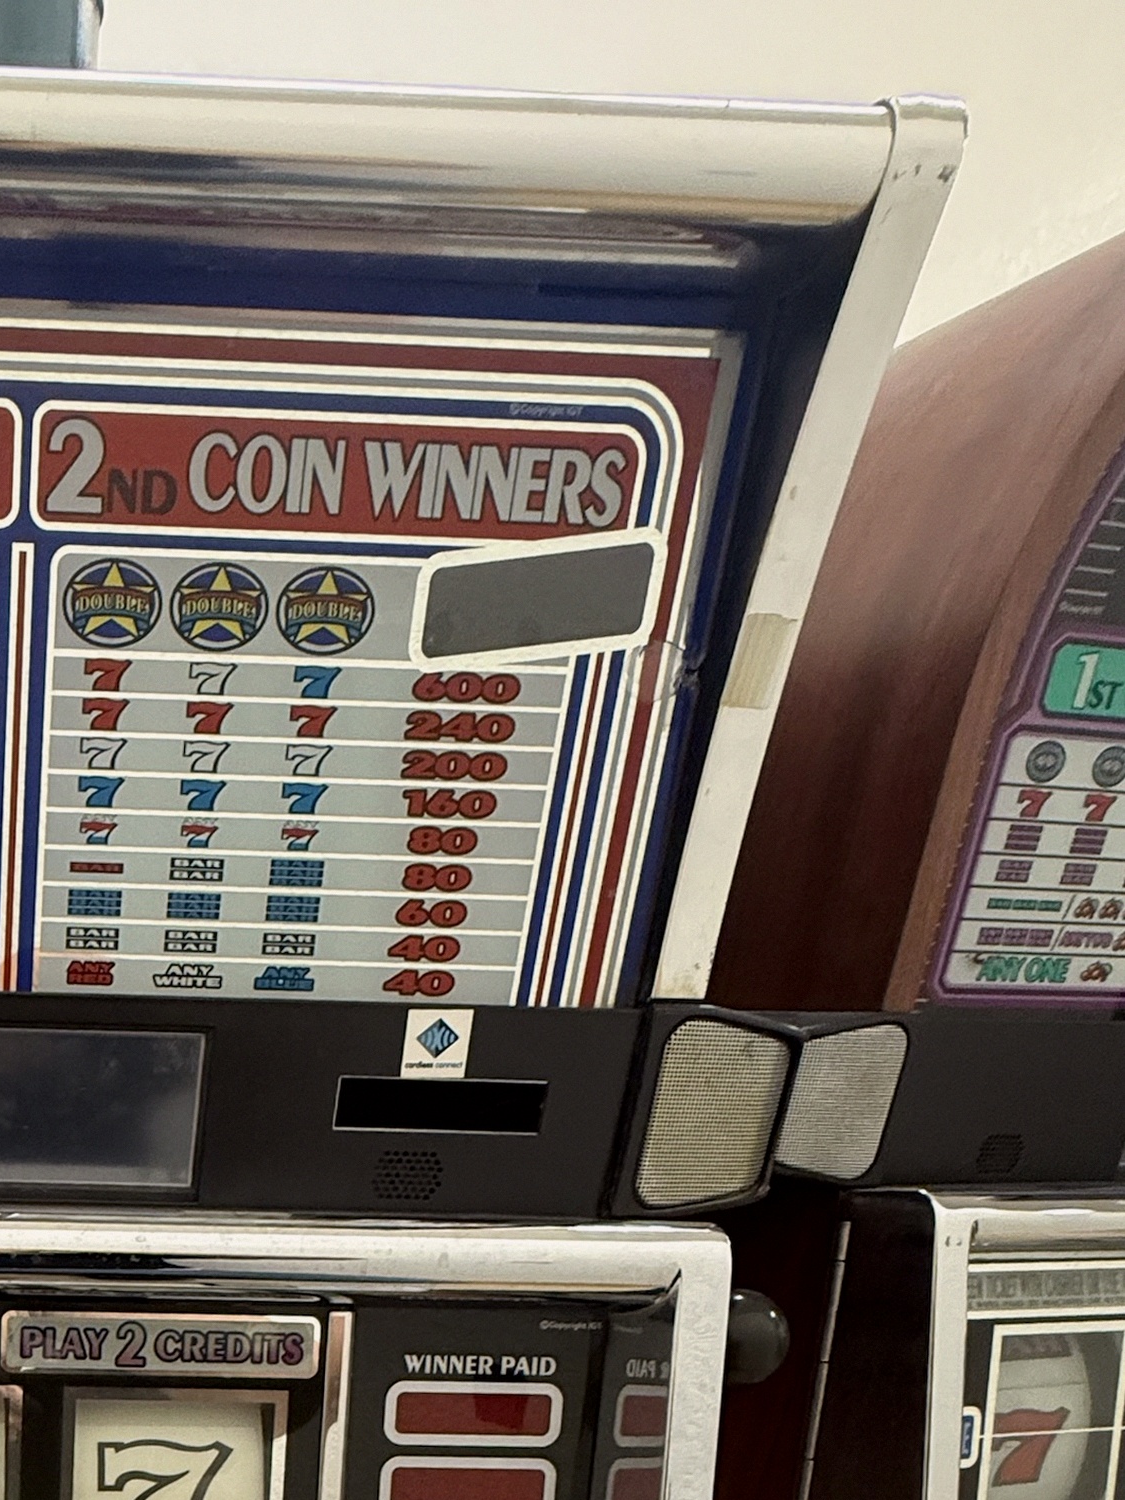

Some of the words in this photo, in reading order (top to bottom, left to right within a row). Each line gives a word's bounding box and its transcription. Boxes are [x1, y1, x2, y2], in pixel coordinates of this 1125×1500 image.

[45, 416, 177, 516] 2ND
[187, 430, 346, 516] COIN
[362, 440, 627, 529] WINNERS
[78, 594, 150, 616] DOUBLE
[186, 597, 256, 620] DOUBLE
[291, 601, 364, 623] DOUBLE
[411, 671, 522, 706] 600
[404, 708, 516, 744] 240
[400, 749, 508, 782] 200
[402, 788, 497, 821] 160
[407, 825, 478, 856] 80
[402, 863, 472, 892] 80
[395, 899, 469, 928] 60
[387, 935, 461, 963] 40
[383, 969, 455, 997] 40
[404, 1060, 433, 1069] cordless
[435, 1061, 463, 1069] connect
[20, 1325, 108, 1362] PLAY
[114, 1320, 148, 1368] 2
[153, 1327, 305, 1366] CREDITS
[404, 1353, 493, 1376] WINNER
[500, 1355, 557, 1377] PAID
